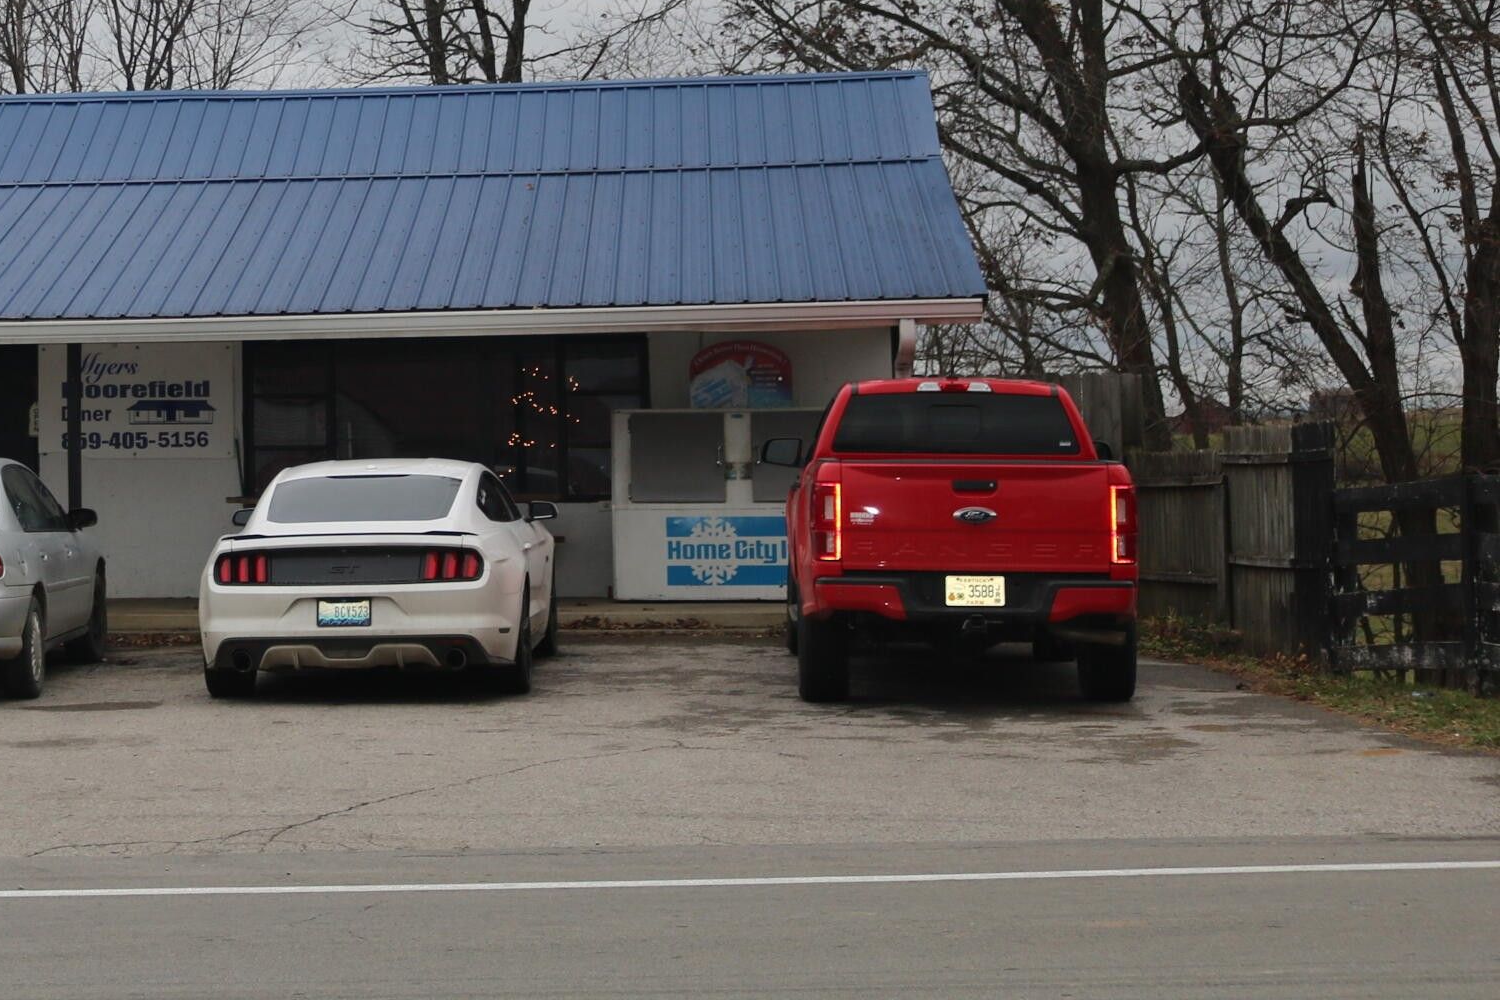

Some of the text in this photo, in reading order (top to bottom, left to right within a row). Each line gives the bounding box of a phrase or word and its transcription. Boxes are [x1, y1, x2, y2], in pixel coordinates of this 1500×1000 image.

[61, 406, 112, 422] Dner
[667, 541, 731, 559] Home
[735, 540, 777, 563] City
[850, 541, 1102, 557] RANGER
[968, 584, 994, 598] 3588
